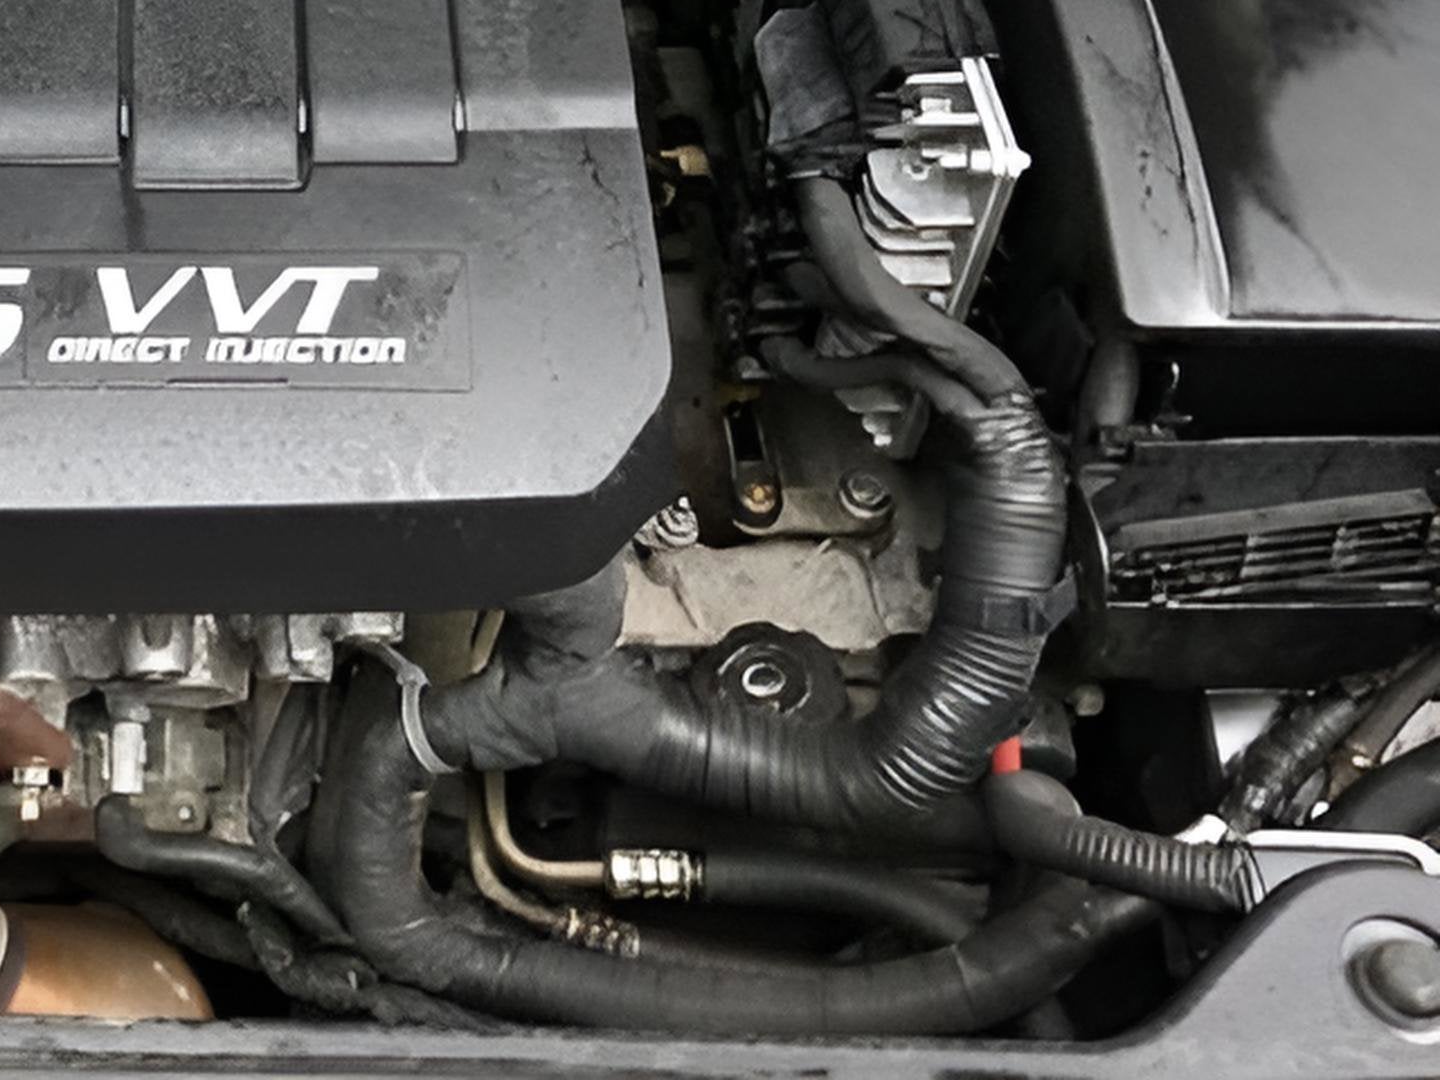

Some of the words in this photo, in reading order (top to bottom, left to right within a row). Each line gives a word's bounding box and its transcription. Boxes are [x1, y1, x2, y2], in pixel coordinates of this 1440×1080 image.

[96, 266, 379, 334] VVT
[47, 337, 192, 363] DIRECT
[204, 337, 407, 364] INJECTION
